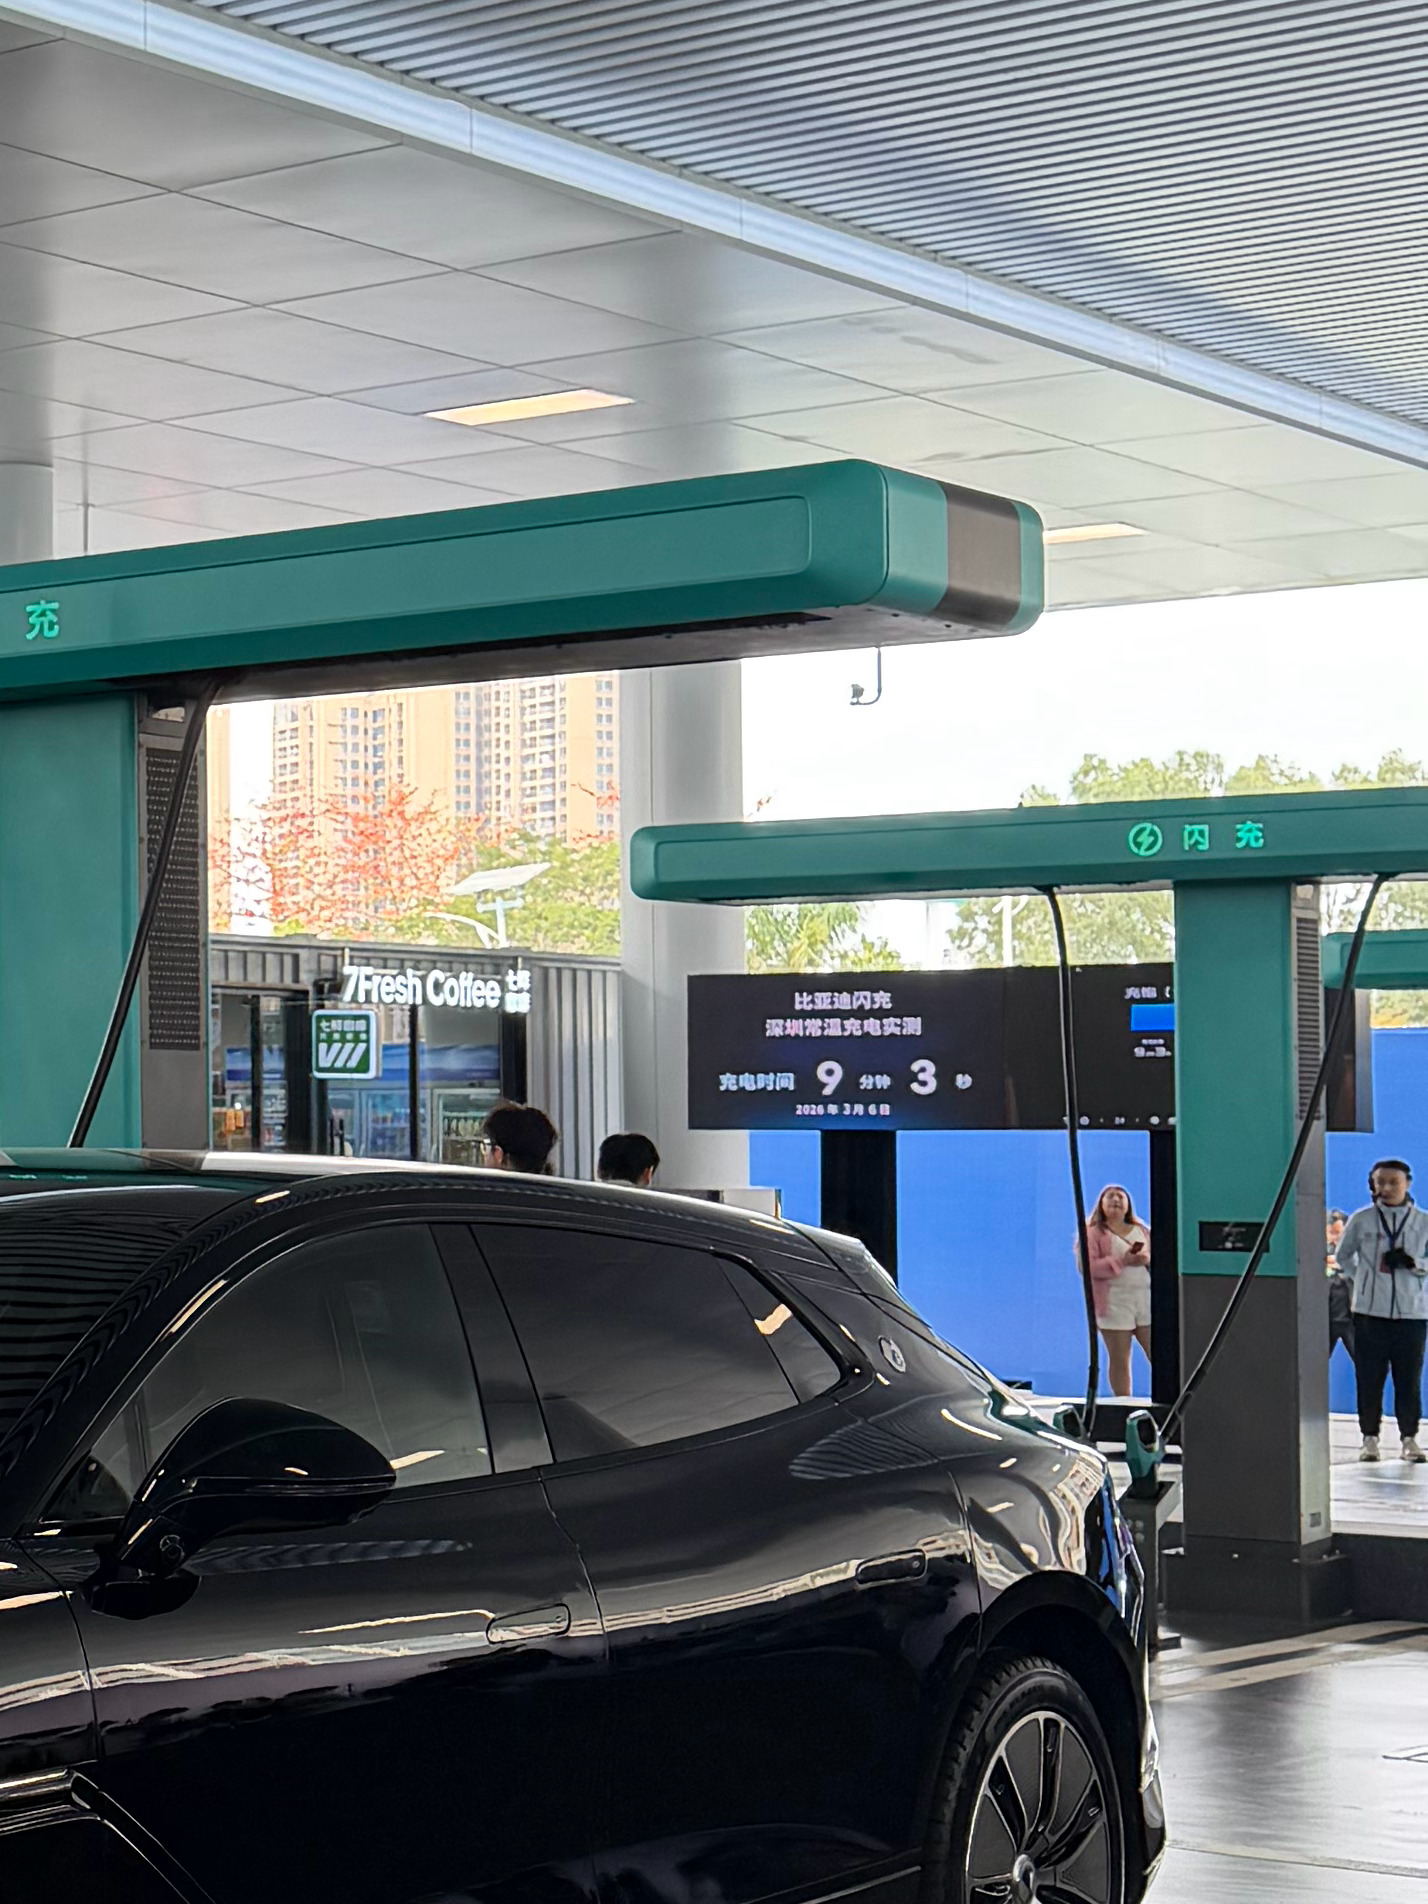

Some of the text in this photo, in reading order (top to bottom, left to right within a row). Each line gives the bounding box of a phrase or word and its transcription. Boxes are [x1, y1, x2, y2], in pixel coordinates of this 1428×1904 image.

[1183, 820, 1265, 851] 闪充
[343, 965, 423, 1005] 7Fresh
[426, 969, 502, 1008] Coffee
[794, 990, 893, 1011] 比亚迪闪充
[765, 1016, 922, 1037] 深圳常温充电实测
[719, 1072, 795, 1091] 充电时间
[816, 1059, 843, 1096] 9
[859, 1073, 891, 1090] 分钟
[909, 1058, 938, 1096] 3
